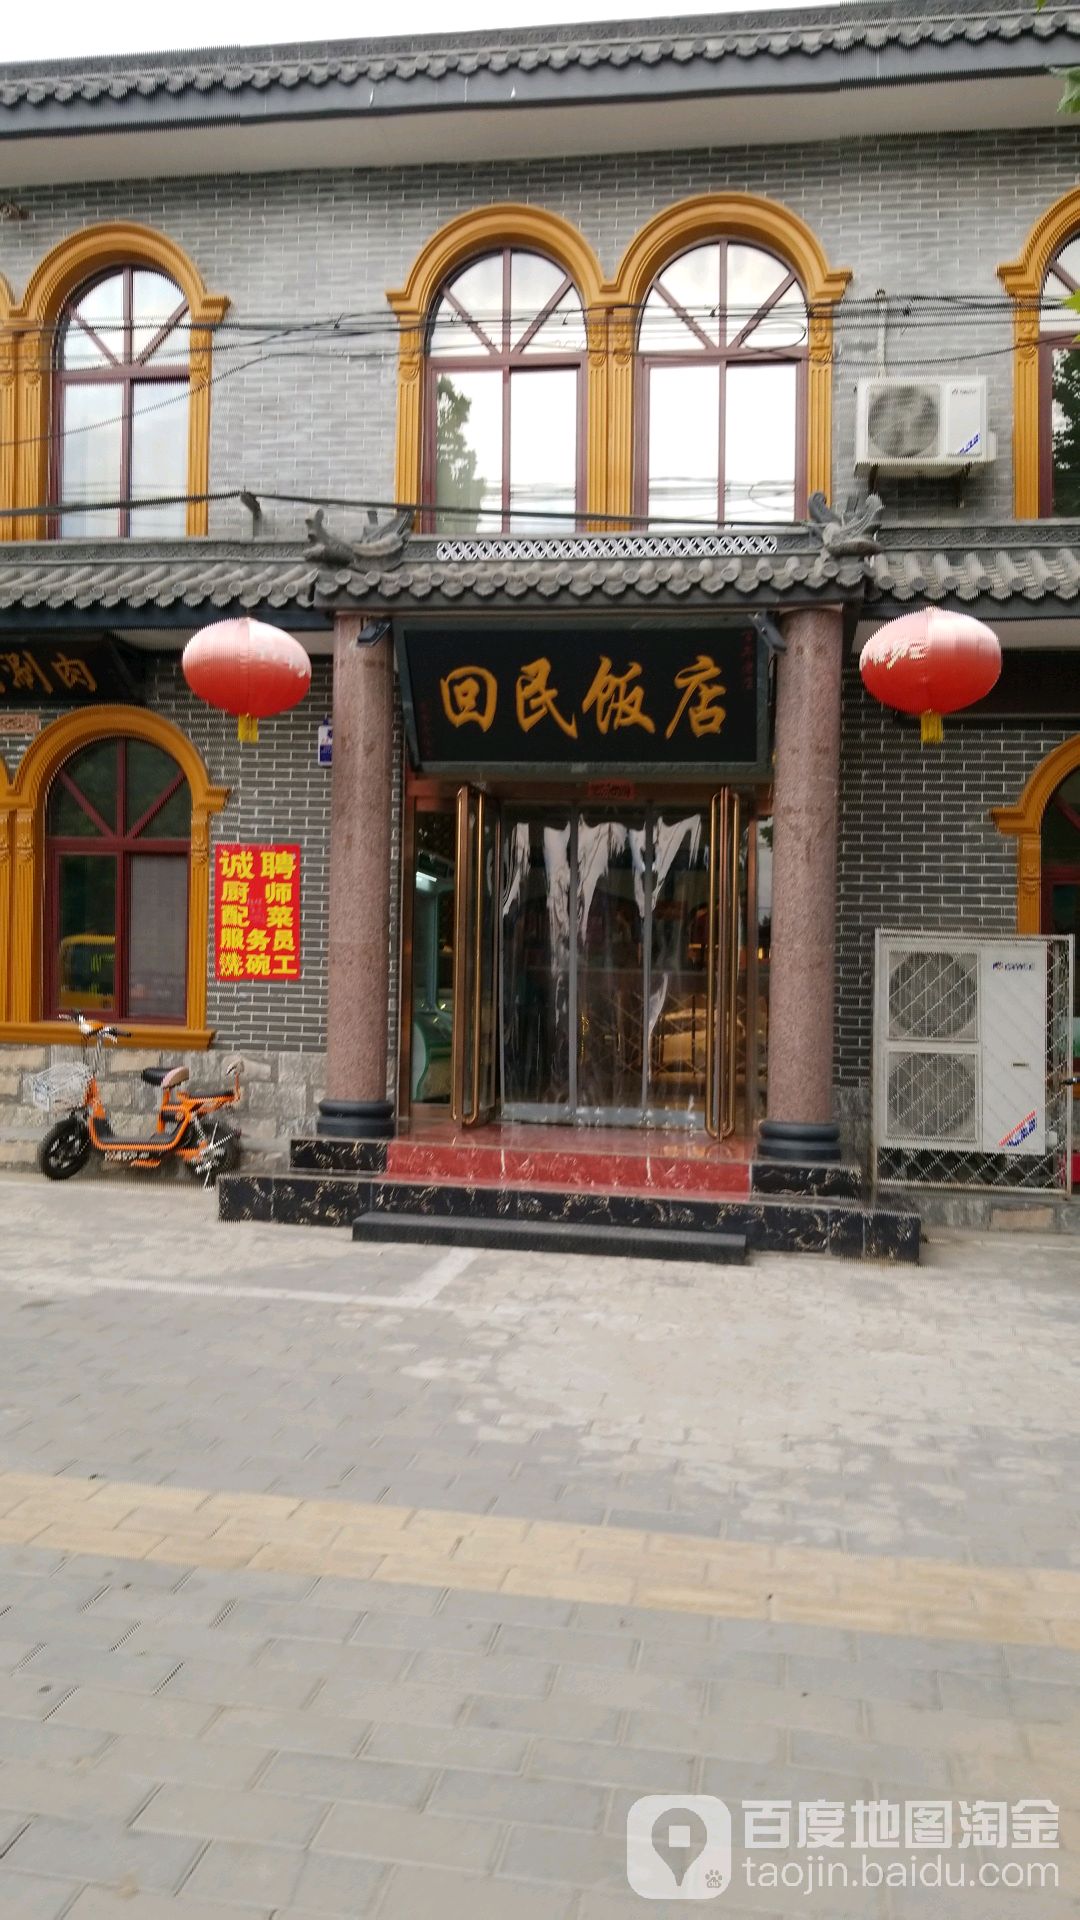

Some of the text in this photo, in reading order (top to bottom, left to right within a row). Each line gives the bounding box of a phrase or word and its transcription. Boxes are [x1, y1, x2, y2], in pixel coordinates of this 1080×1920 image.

[440, 656, 726, 739] 回民饭店
[219, 850, 296, 880] 诚聘
[221, 881, 293, 905] 厨师
[220, 905, 294, 928] 配菜
[220, 927, 295, 952] 服务员
[219, 953, 298, 977] 洗碗工
